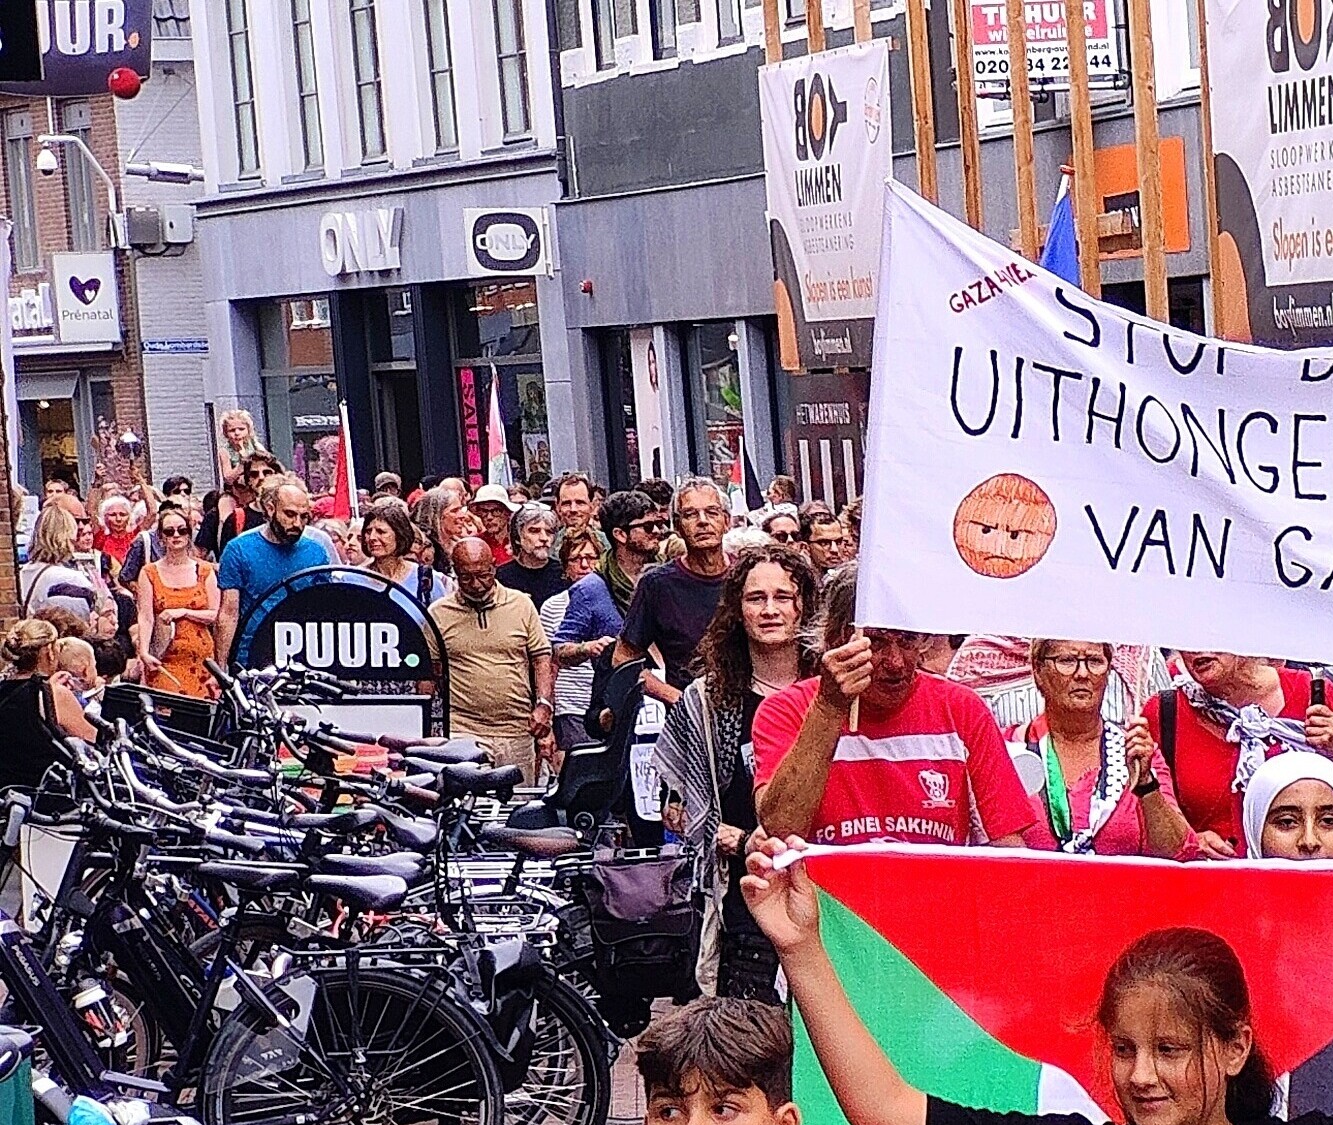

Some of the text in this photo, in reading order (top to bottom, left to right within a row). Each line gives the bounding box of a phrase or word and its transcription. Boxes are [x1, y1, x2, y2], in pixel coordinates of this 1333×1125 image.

[1025, 2, 1096, 24] HUR
[975, 60, 1009, 74] 020
[795, 163, 842, 207] LIMMEN
[320, 207, 404, 277] ONLY
[475, 233, 537, 250] ONLY
[1272, 217, 1308, 272] Slopen
[1311, 217, 1321, 258] is
[949, 276, 1003, 313] GAZA
[61, 308, 114, 321] Prénatal
[1085, 504, 1232, 579] VAN
[840, 816, 882, 837] BNEI
[885, 816, 956, 842] SAKHNIN
[11, 944, 41, 988] PEGASUS
